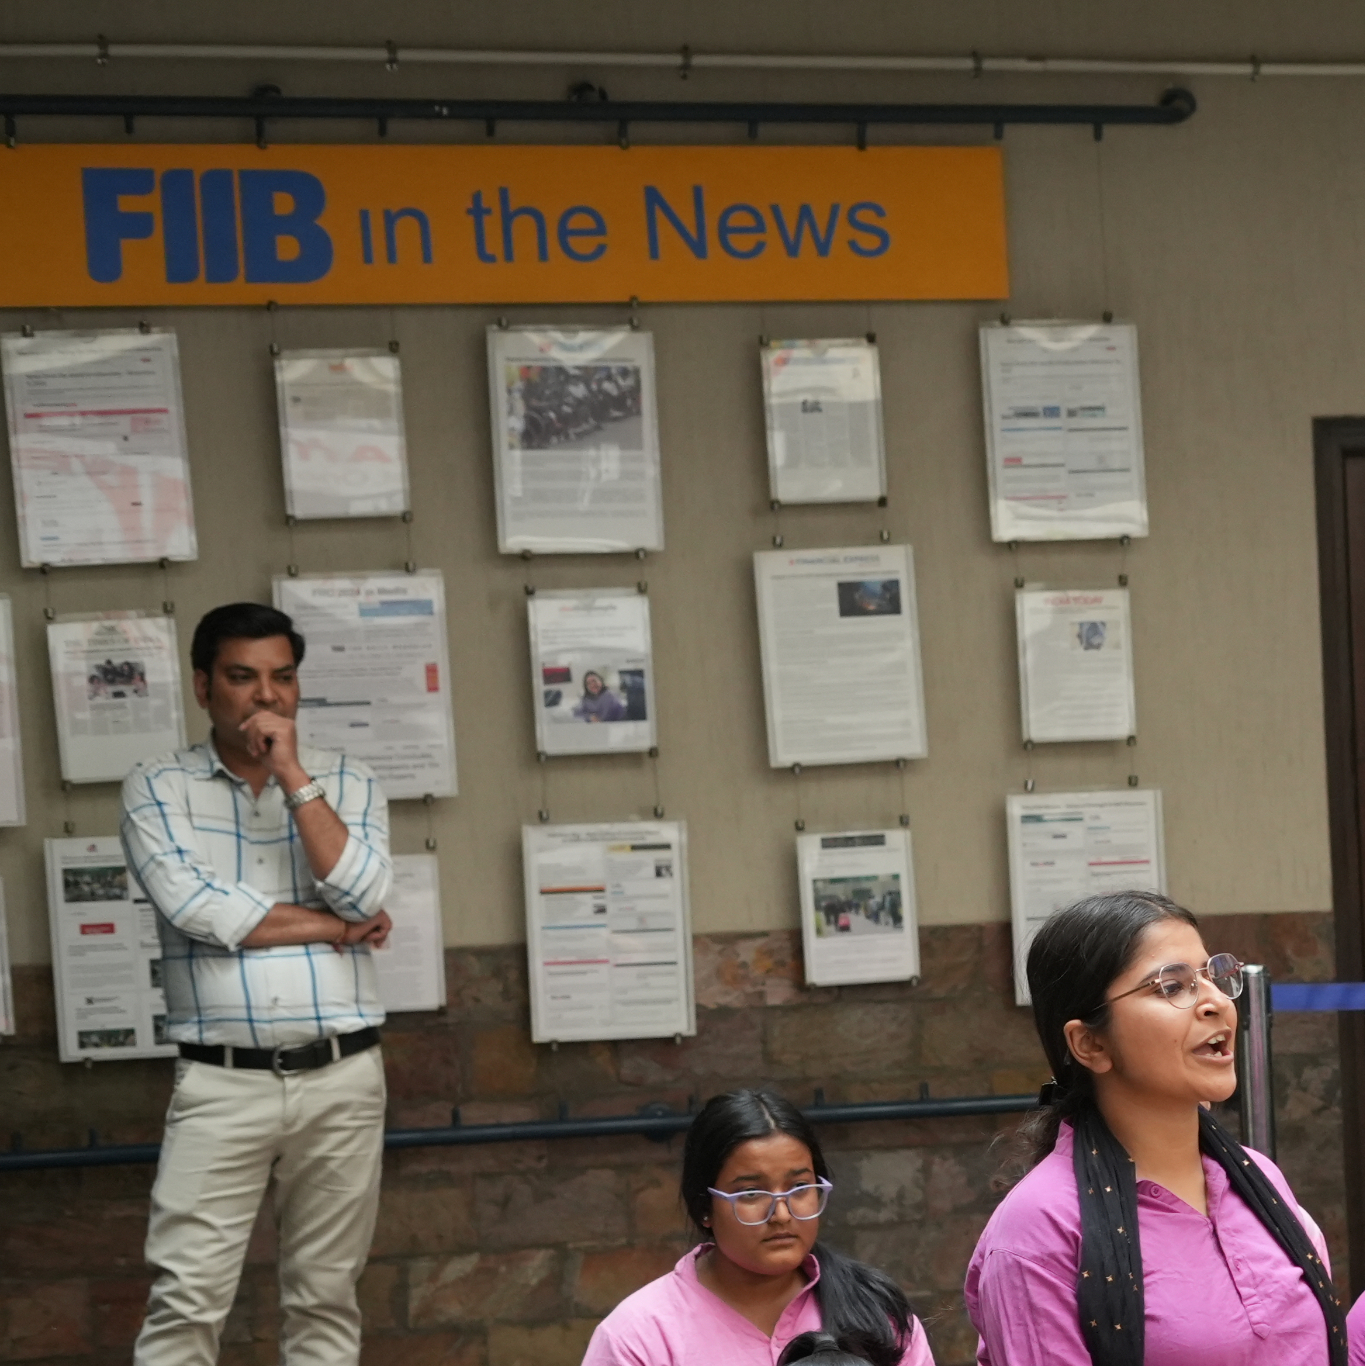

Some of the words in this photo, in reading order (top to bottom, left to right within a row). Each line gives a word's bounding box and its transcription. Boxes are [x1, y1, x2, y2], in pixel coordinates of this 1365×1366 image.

[82, 168, 334, 283] FIIB
[362, 208, 432, 265] in
[467, 187, 607, 263] the
[645, 186, 890, 259] News
